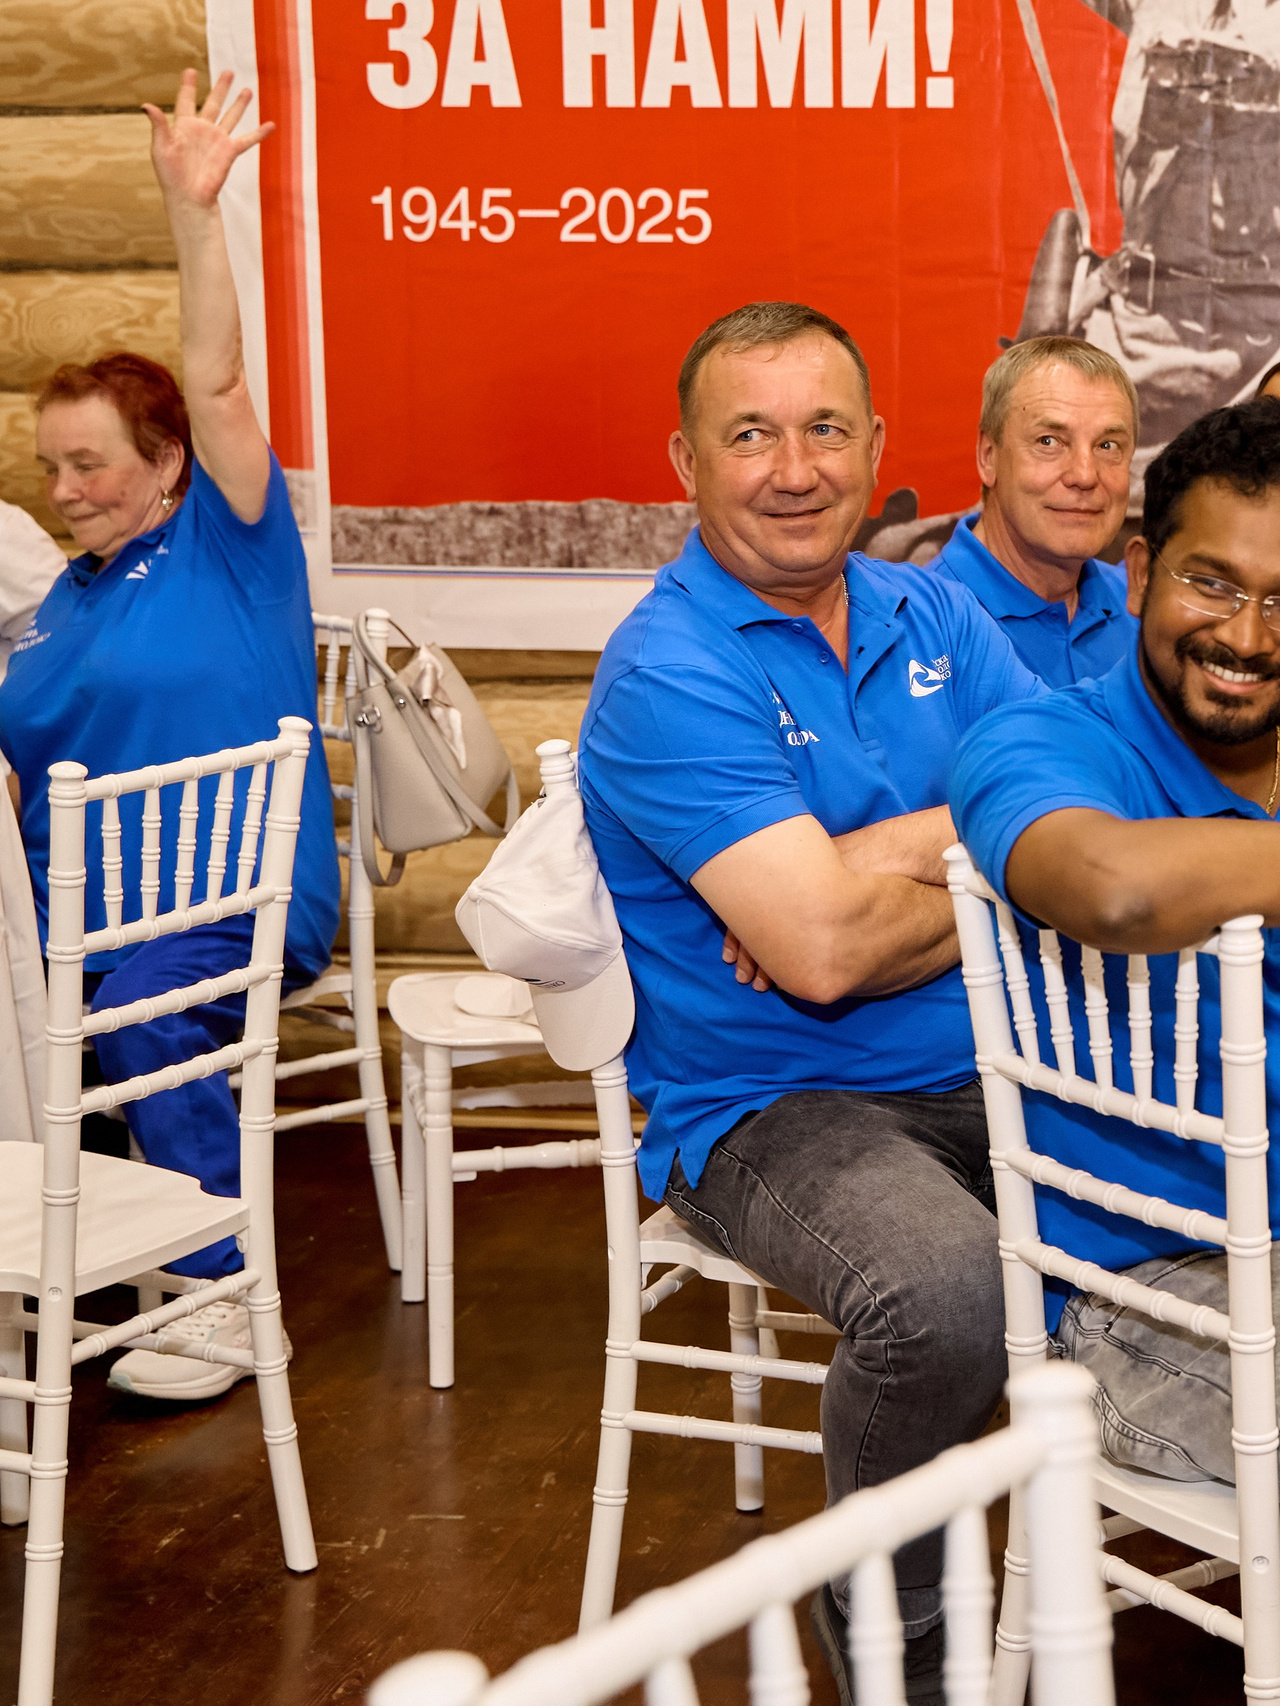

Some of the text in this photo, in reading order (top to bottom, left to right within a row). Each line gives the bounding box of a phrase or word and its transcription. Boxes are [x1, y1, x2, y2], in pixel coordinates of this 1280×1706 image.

[366, 0, 954, 109] ЗА НАМИ!
[371, 185, 713, 244] 1945–2025
